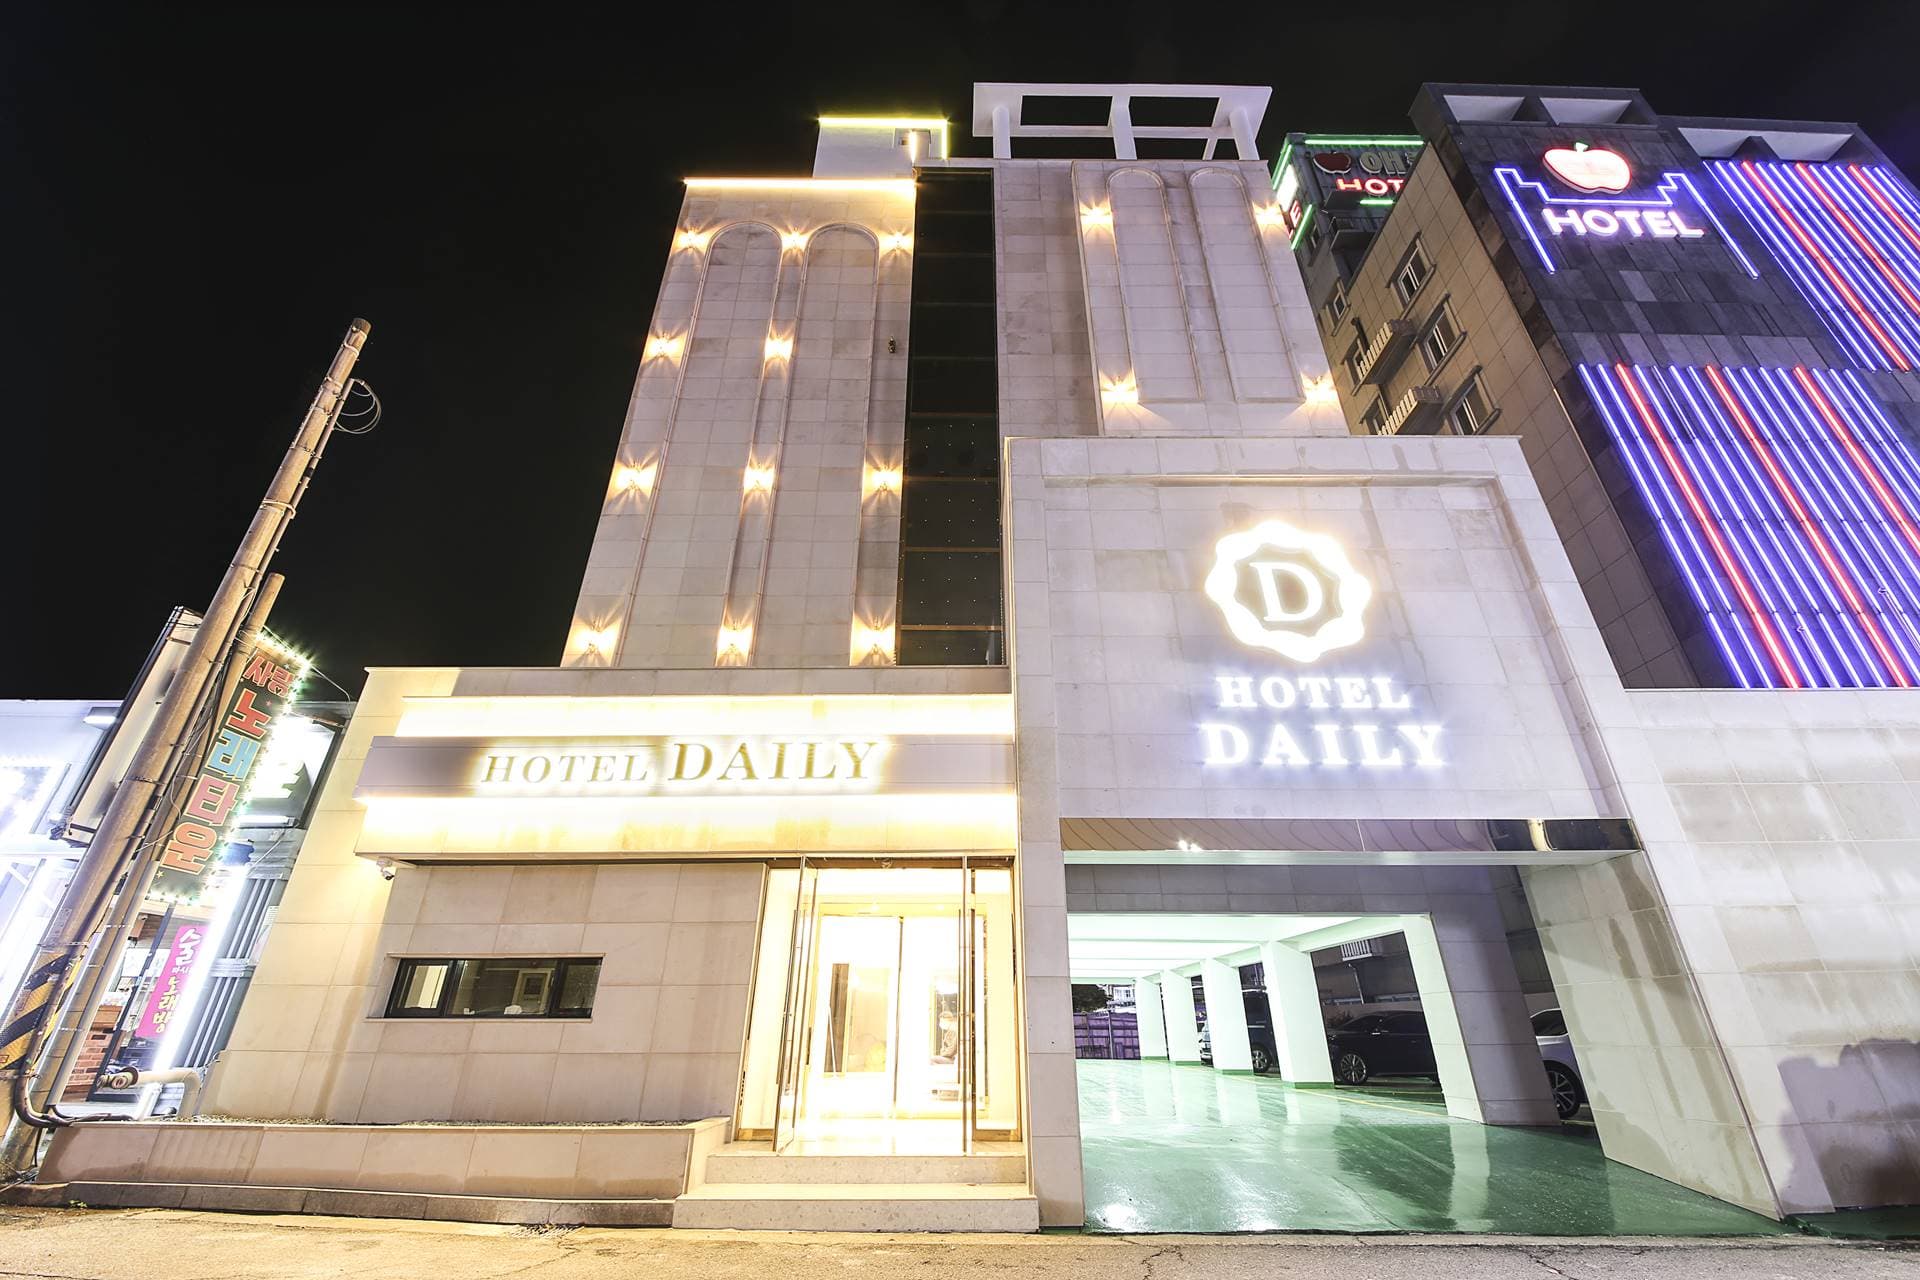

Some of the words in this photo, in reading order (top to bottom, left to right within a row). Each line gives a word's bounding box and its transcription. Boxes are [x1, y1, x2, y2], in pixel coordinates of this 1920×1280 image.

[1541, 208, 1705, 239] HOTEL
[1248, 561, 1323, 622] D
[242, 655, 296, 698] 사랑
[1215, 676, 1411, 709] HOTEL
[481, 754, 649, 784] HOTEL
[667, 741, 880, 782] DAILY
[1200, 723, 1443, 767] DAILY
[159, 687, 273, 876] 노래타운
